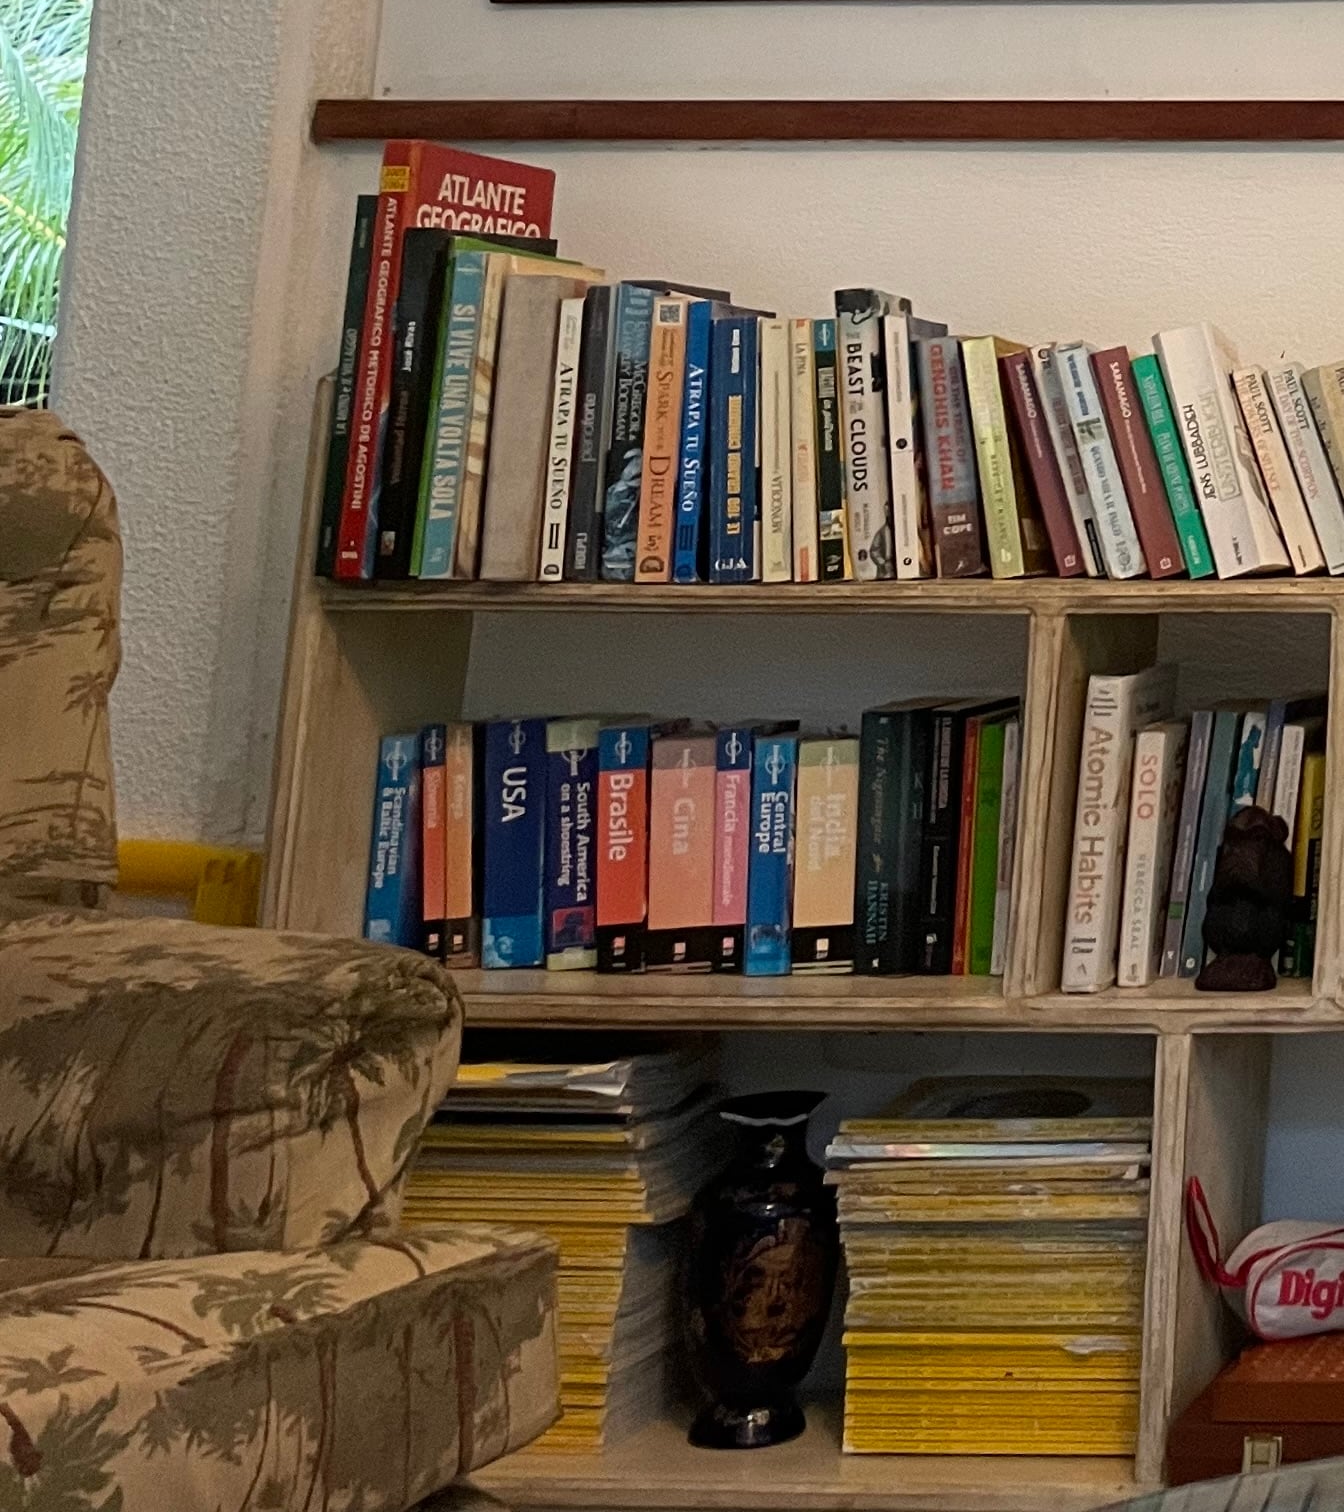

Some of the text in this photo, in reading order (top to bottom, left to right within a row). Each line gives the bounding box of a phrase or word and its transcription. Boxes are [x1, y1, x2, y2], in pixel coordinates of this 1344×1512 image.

[416, 204, 541, 239] GEOGRAFICO
[438, 173, 527, 216] ATLANTE
[380, 197, 398, 258] ATLANTE
[371, 261, 390, 347] GEOGRAFICO
[401, 321, 417, 372] José Rivas
[846, 343, 865, 396] BEAST
[362, 350, 380, 421] METODICO
[429, 303, 476, 520] SI VIVE UNA VOLTA SOLA
[615, 378, 633, 440] BOORMAN
[1016, 363, 1038, 418] SARAMAGO
[1110, 361, 1132, 418] SARAMAGO
[1245, 373, 1273, 433] PAUL SCOTT
[1283, 369, 1310, 430] PAUL SCOTT
[357, 424, 371, 443] DE
[549, 362, 575, 509] ATRAPA TU SUEÑO
[581, 393, 598, 462] pianoforte
[648, 370, 674, 527] SPARK DREAM
[681, 364, 705, 511] ATRAPA TU SUEÑO
[929, 344, 956, 492] GENGHIS KHAN
[351, 445, 368, 510] AGOSTINI
[851, 418, 868, 492] CLOUDS
[1183, 404, 1217, 499] JENS LUBBADEH
[943, 523, 972, 535] COPE
[876, 738, 889, 762] The
[501, 766, 527, 823] USA
[608, 772, 635, 861] Brasile
[672, 796, 695, 855] Cina
[724, 774, 741, 832] Francia
[755, 792, 775, 853] Europe
[772, 791, 788, 853] Central
[824, 793, 846, 857] India
[1074, 726, 1114, 924] Atomic Habits
[372, 788, 393, 888] & Baltic Europe
[387, 787, 406, 875] Scandinavian
[557, 783, 573, 886] on a shoestring
[575, 782, 591, 901] South America
[1130, 754, 1159, 952] SOLO REBECCA SEAL
[865, 879, 878, 945] HANNAH
[878, 881, 890, 941] KRISTIN
